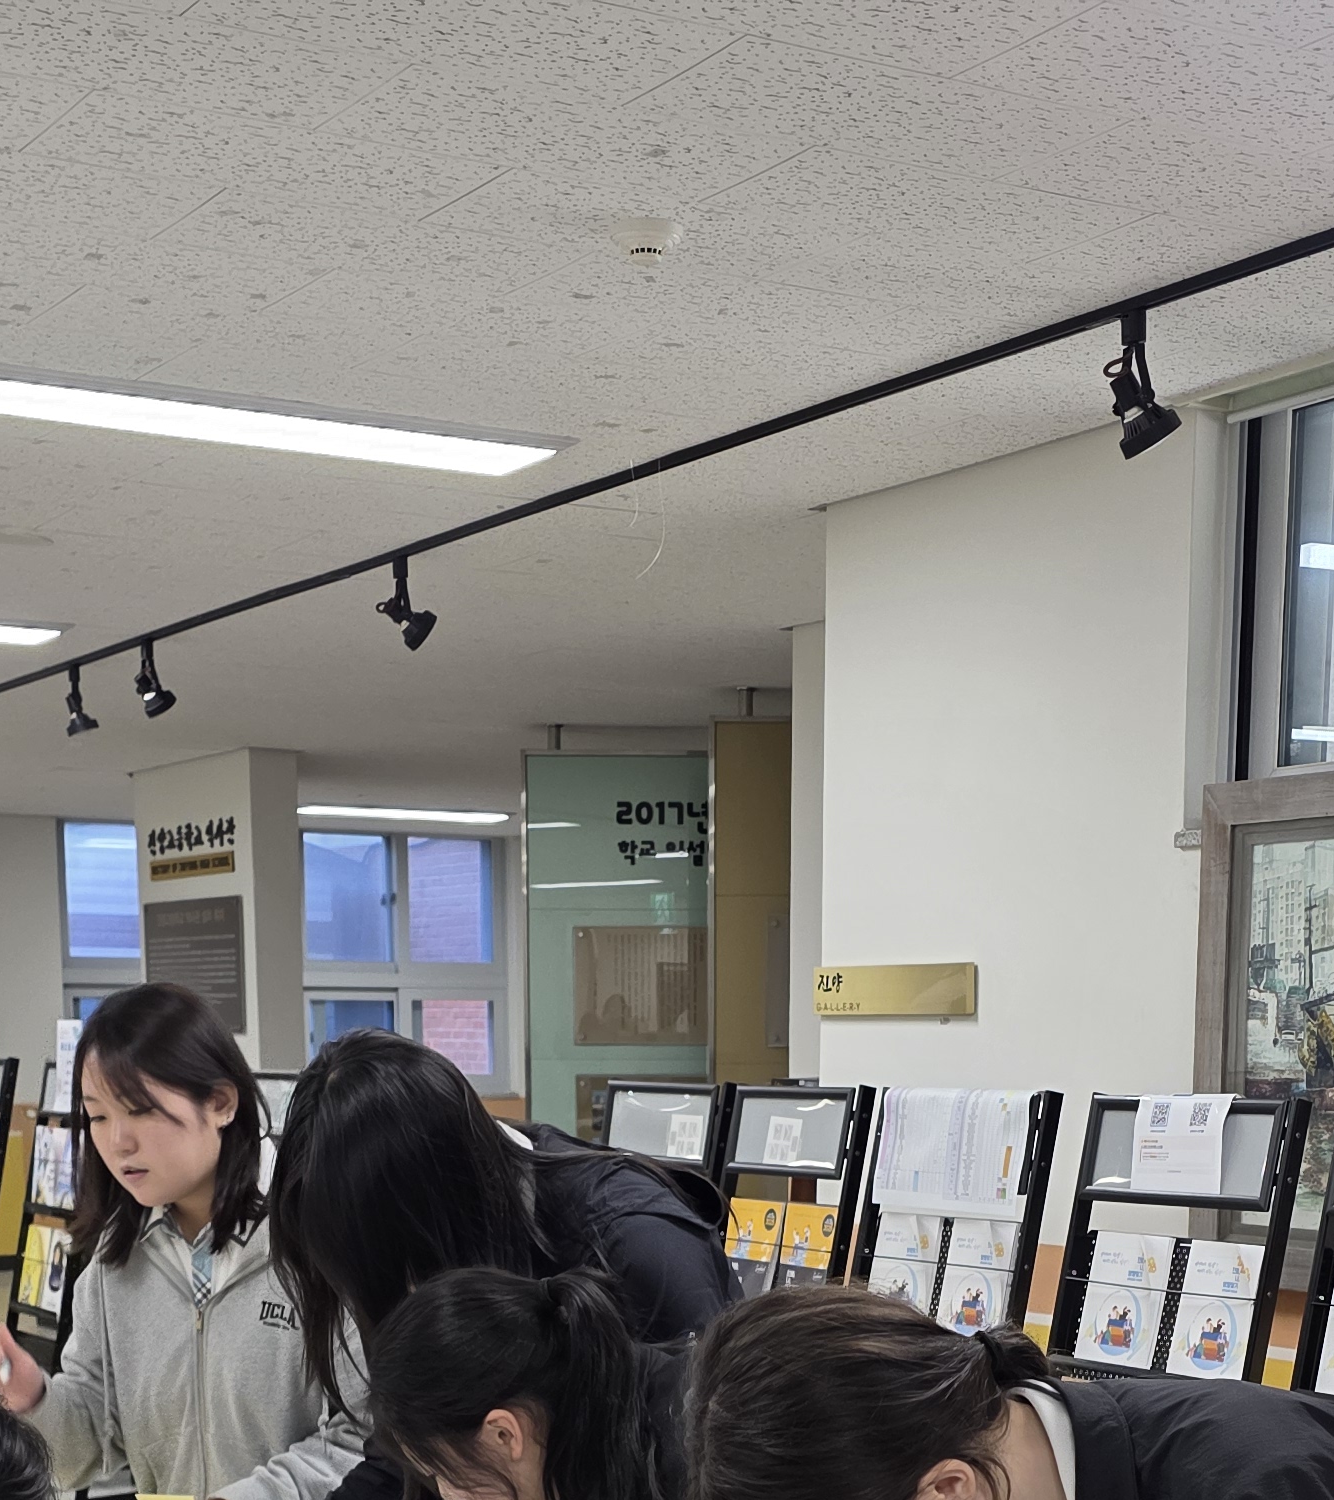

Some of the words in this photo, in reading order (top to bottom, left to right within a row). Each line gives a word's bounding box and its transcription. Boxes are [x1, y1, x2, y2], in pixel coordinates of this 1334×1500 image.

[616, 800, 708, 835] 2017년
[617, 840, 657, 866] 학교
[817, 972, 843, 993] 진양
[259, 1300, 300, 1330] UCLA
